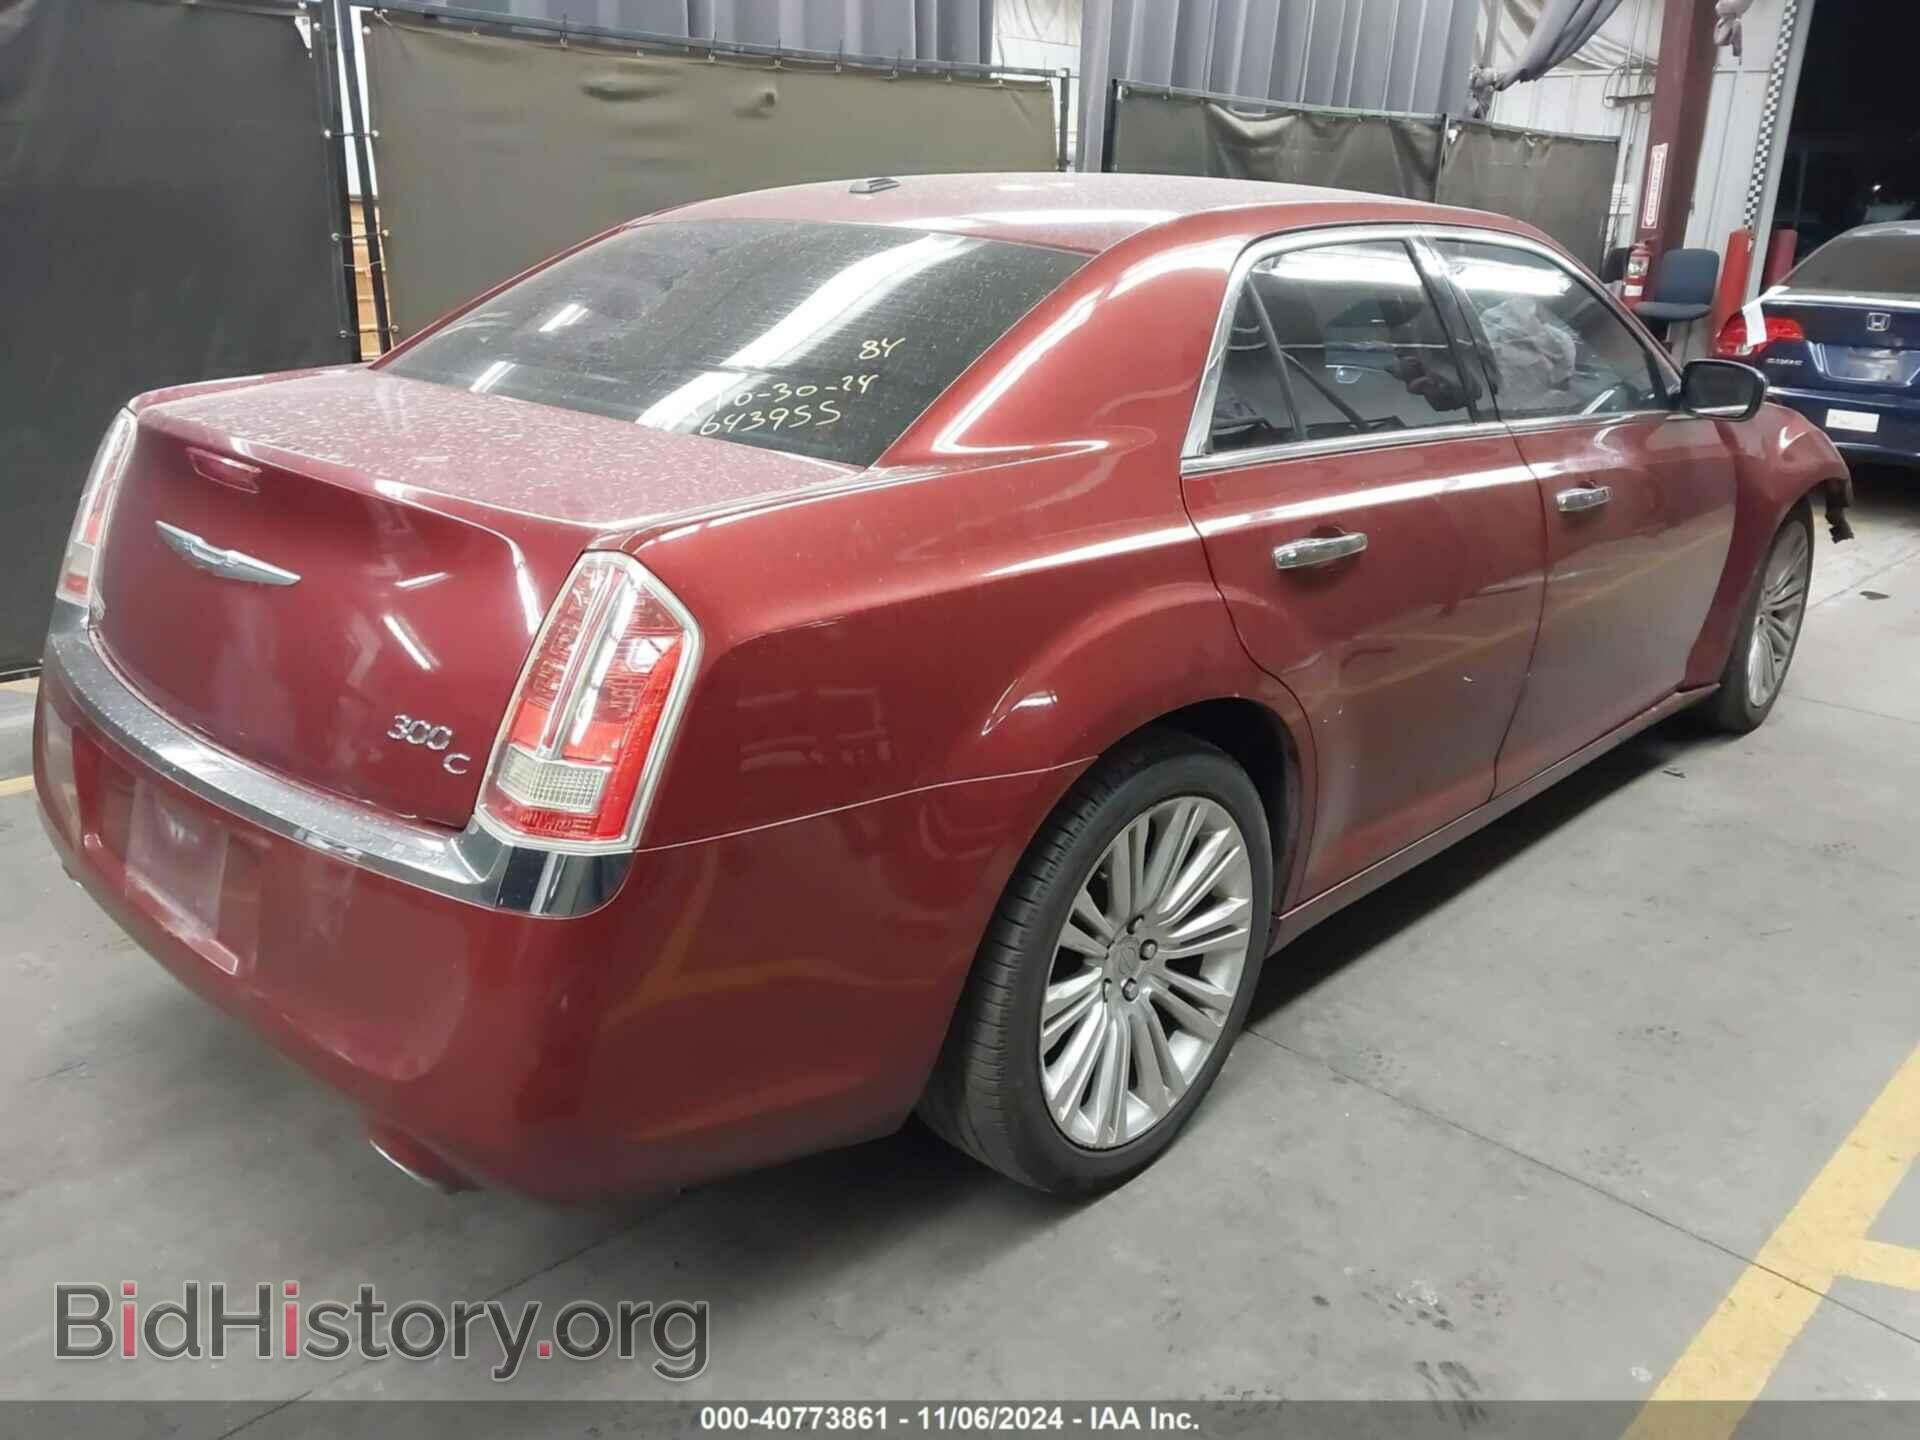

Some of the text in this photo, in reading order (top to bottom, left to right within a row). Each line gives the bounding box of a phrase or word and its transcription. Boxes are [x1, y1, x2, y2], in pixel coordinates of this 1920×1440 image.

[858, 337, 906, 360] 84
[386, 714, 471, 774] 300 C
